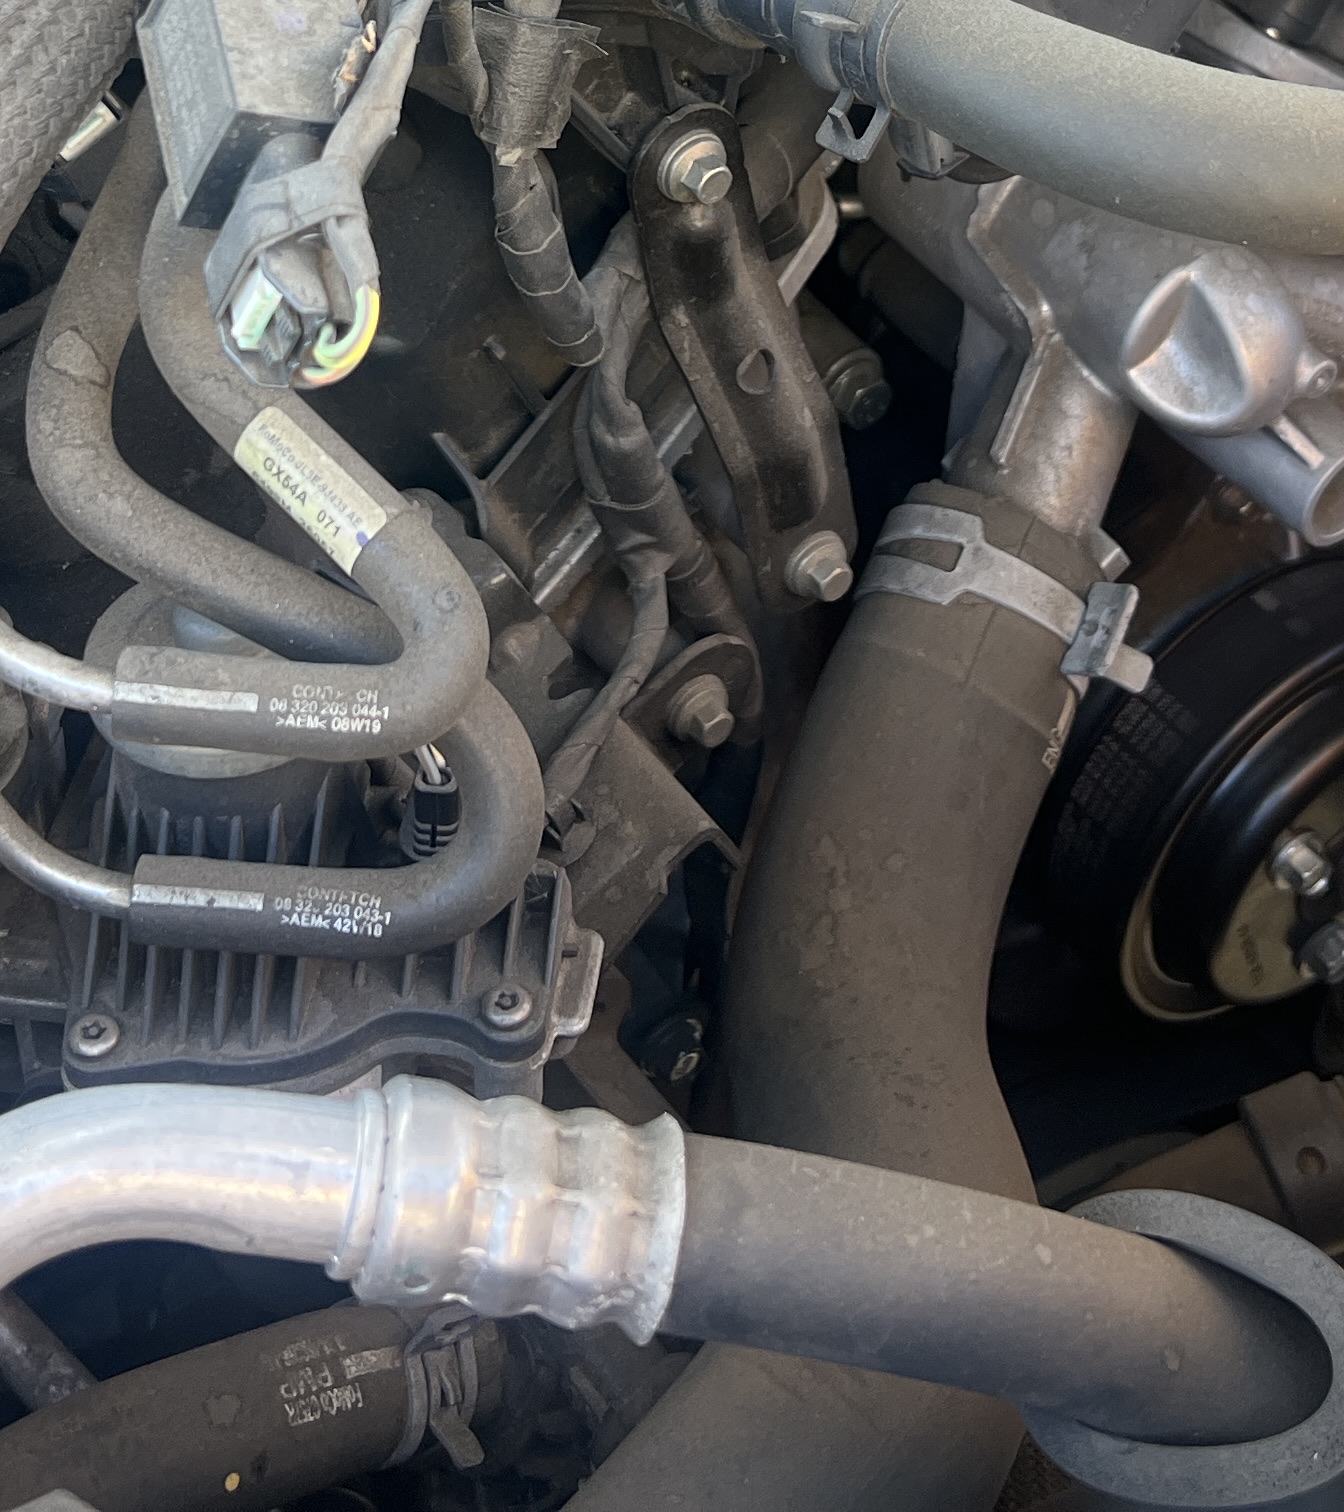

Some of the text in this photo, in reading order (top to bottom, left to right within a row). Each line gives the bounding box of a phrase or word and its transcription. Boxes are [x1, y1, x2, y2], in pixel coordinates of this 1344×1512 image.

[315, 508, 343, 538] 071
[291, 699, 318, 714] 320
[352, 703, 390, 720] 044-1
[331, 716, 382, 735] 08W19
[324, 902, 350, 918] 203
